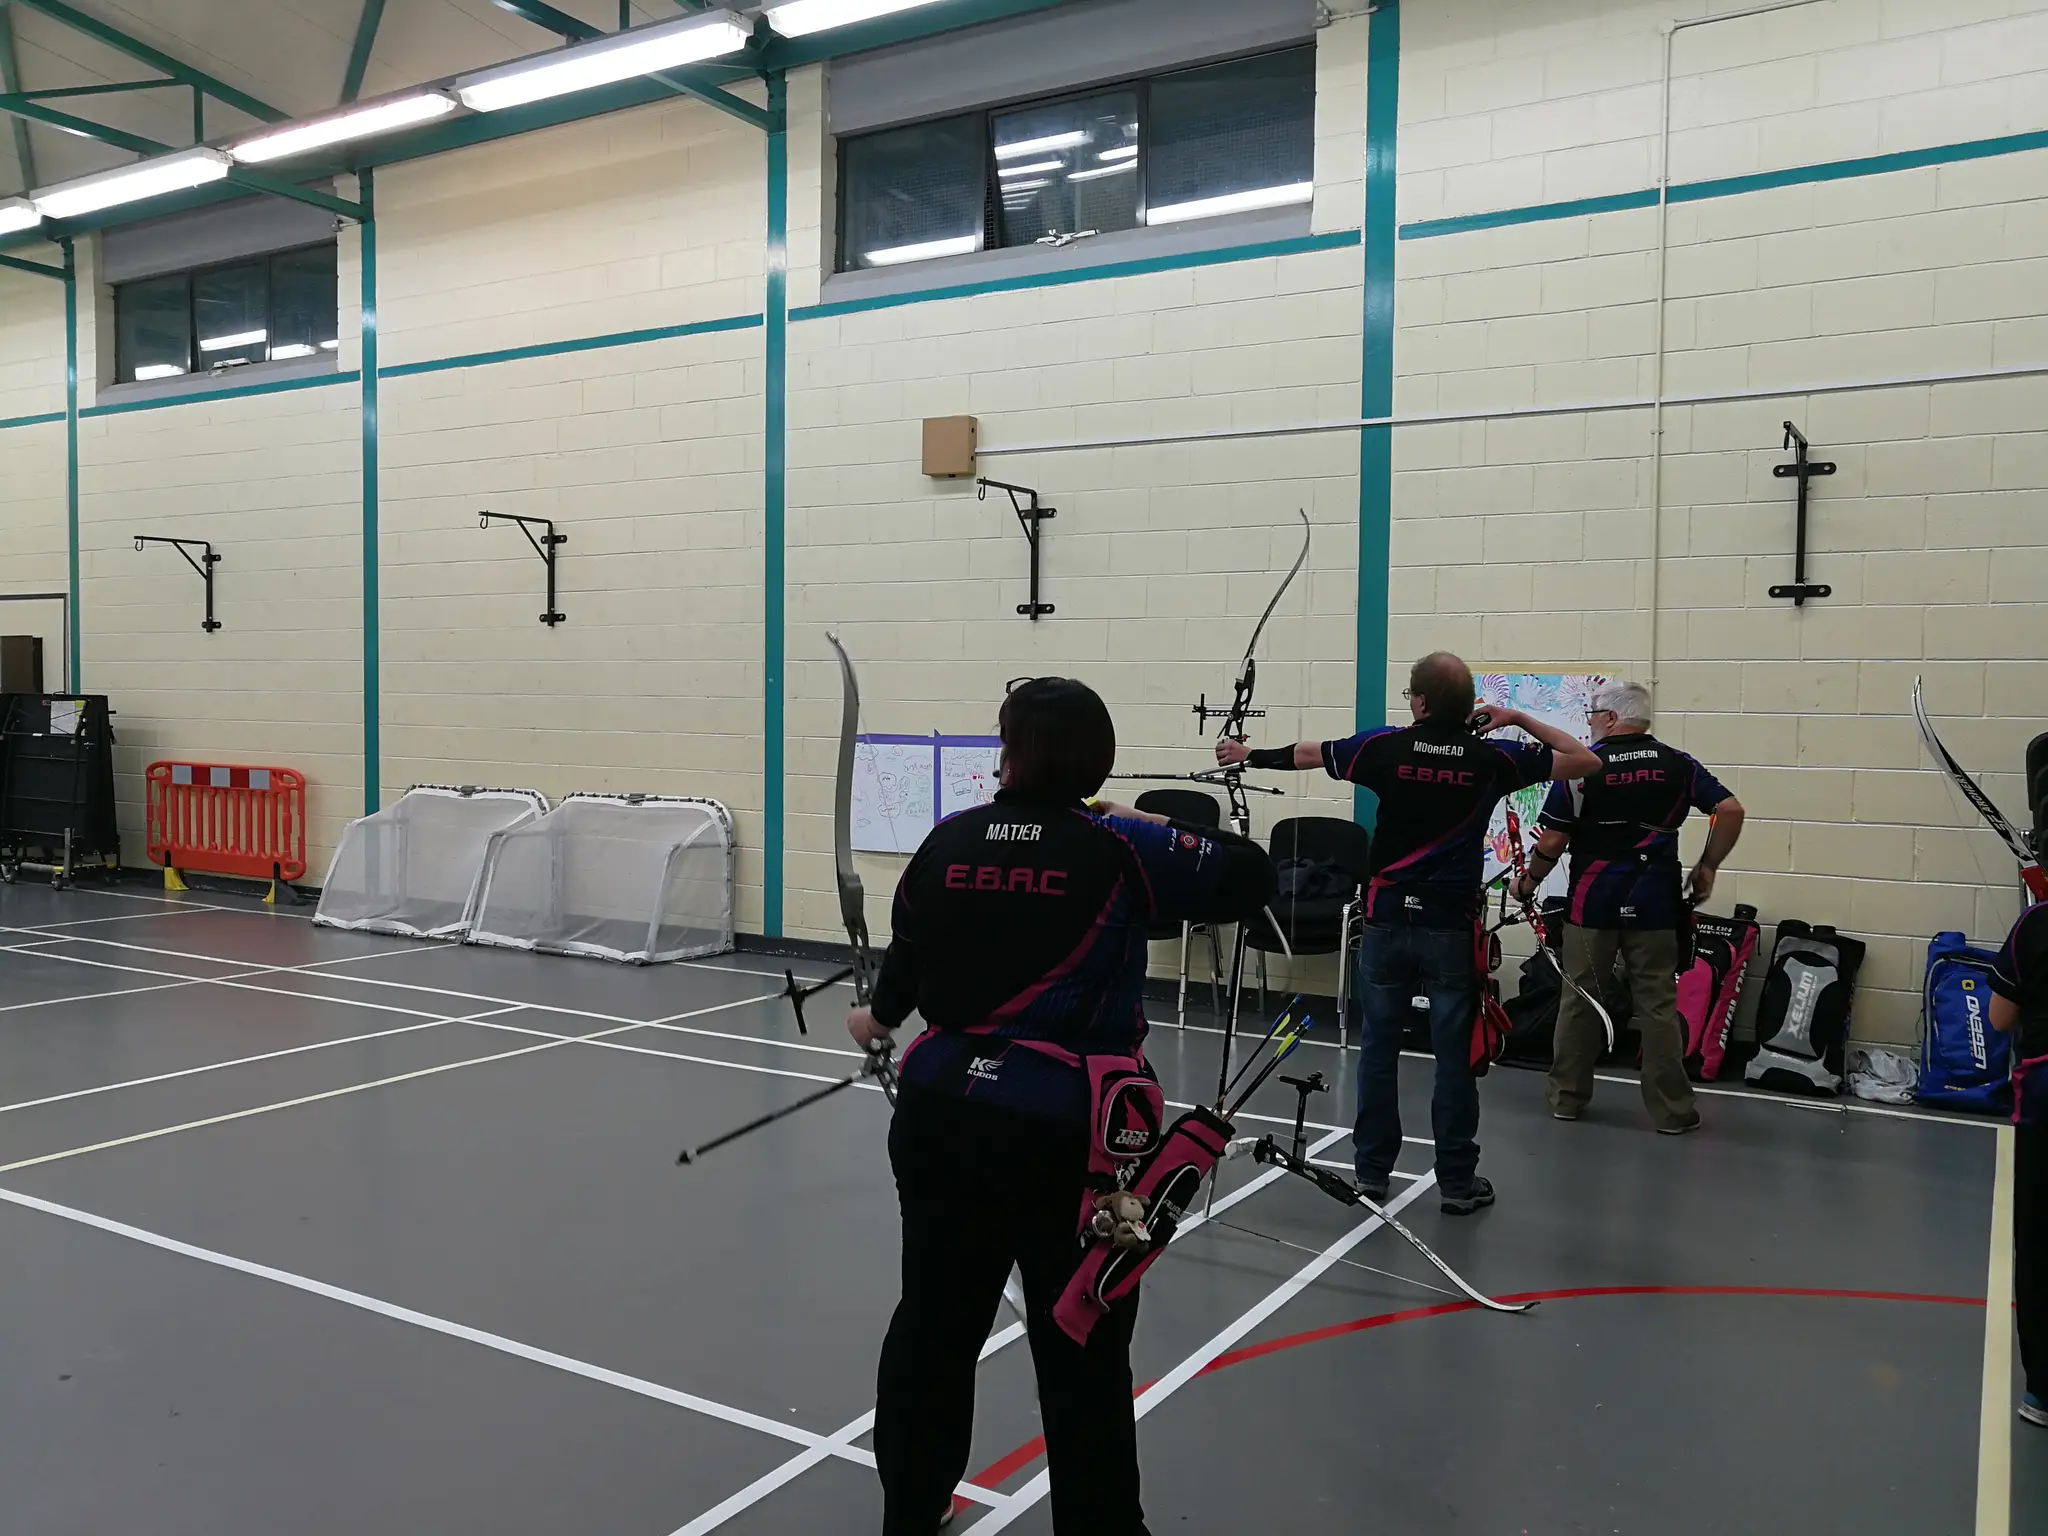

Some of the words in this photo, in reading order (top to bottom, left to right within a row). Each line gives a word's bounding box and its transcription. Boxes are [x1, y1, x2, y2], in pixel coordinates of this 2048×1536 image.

[1413, 740, 1465, 757] MOORHEAD
[1608, 749, 1659, 763] McCUTCHEON
[985, 823, 1043, 841] MATIER
[1696, 923, 1733, 933] VALON
[1965, 995, 1988, 1071] LEGEND
[966, 1068, 999, 1081] KUDOS
